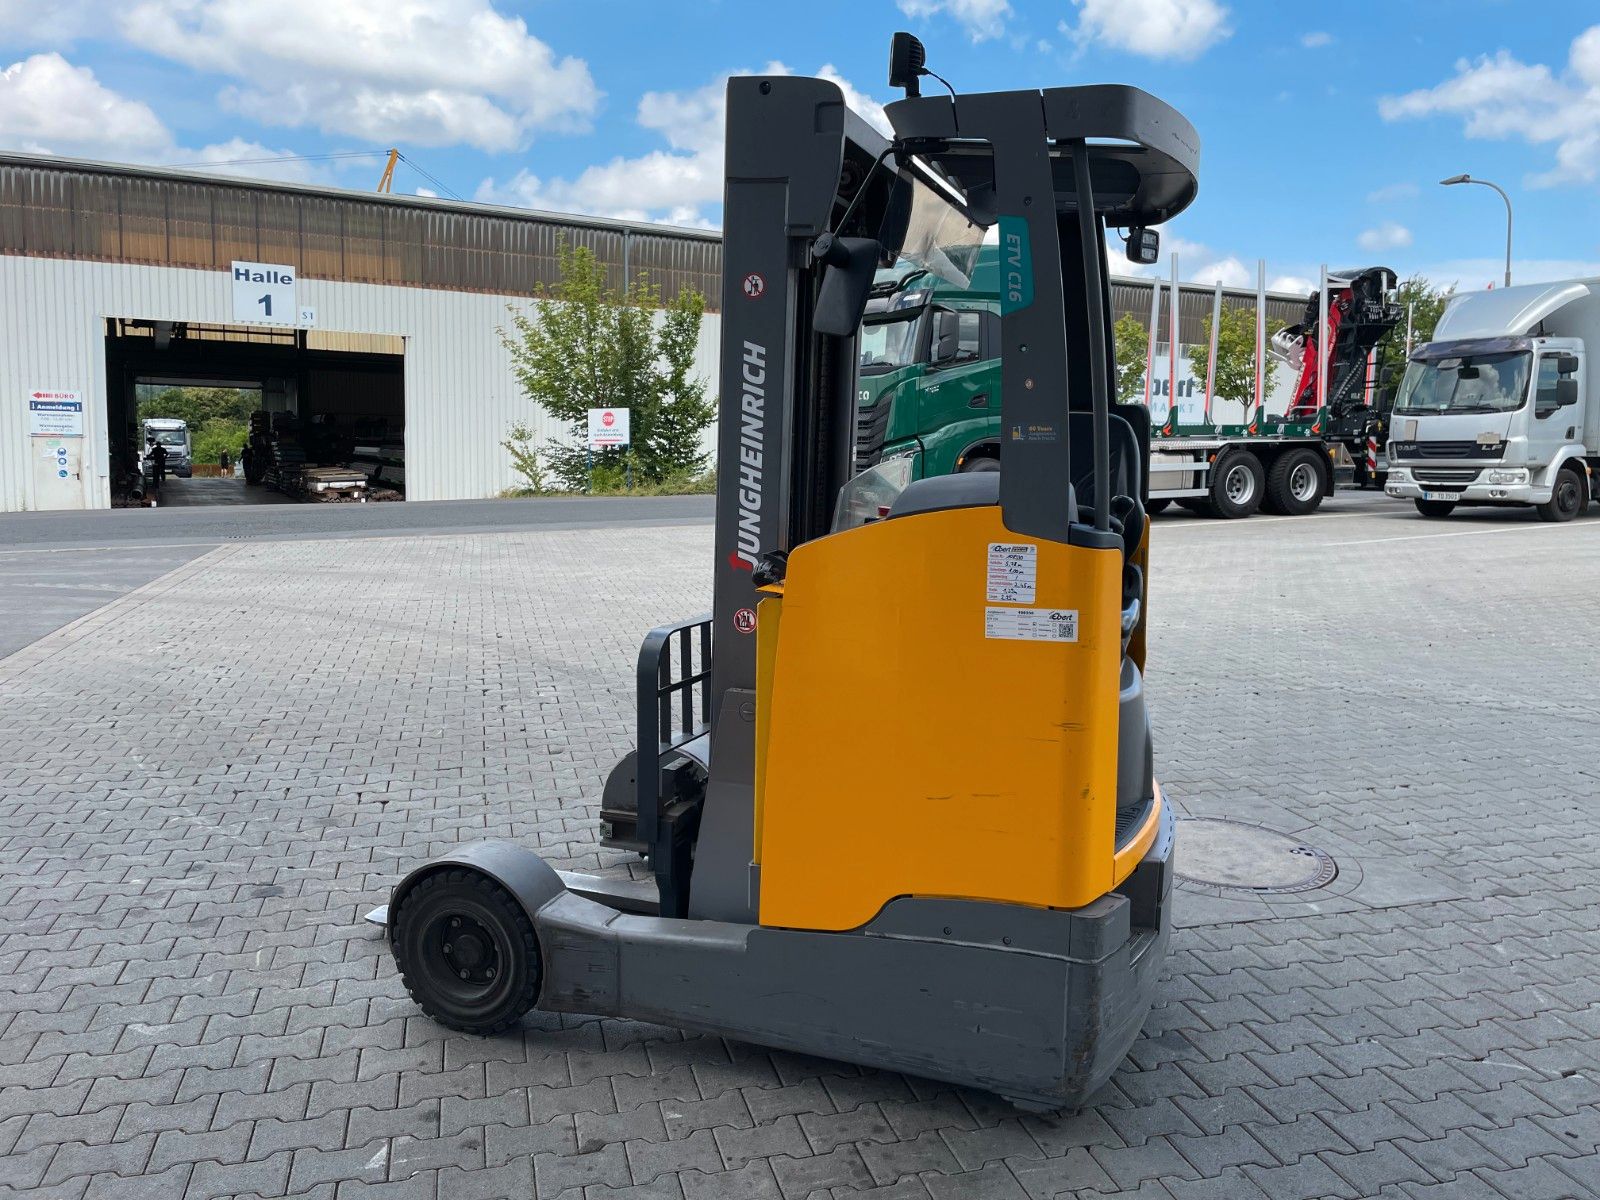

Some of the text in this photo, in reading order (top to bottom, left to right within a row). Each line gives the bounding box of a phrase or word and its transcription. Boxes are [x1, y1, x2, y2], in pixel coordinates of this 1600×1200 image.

[1007, 233, 1022, 302] ETV C16
[235, 268, 293, 285] Halle
[258, 294, 273, 317] 1
[37, 404, 75, 412] Anmeldung
[1151, 403, 1195, 413] MAKT
[729, 340, 767, 571] JUNGHEINRICH
[1050, 612, 1073, 621] Ebert
